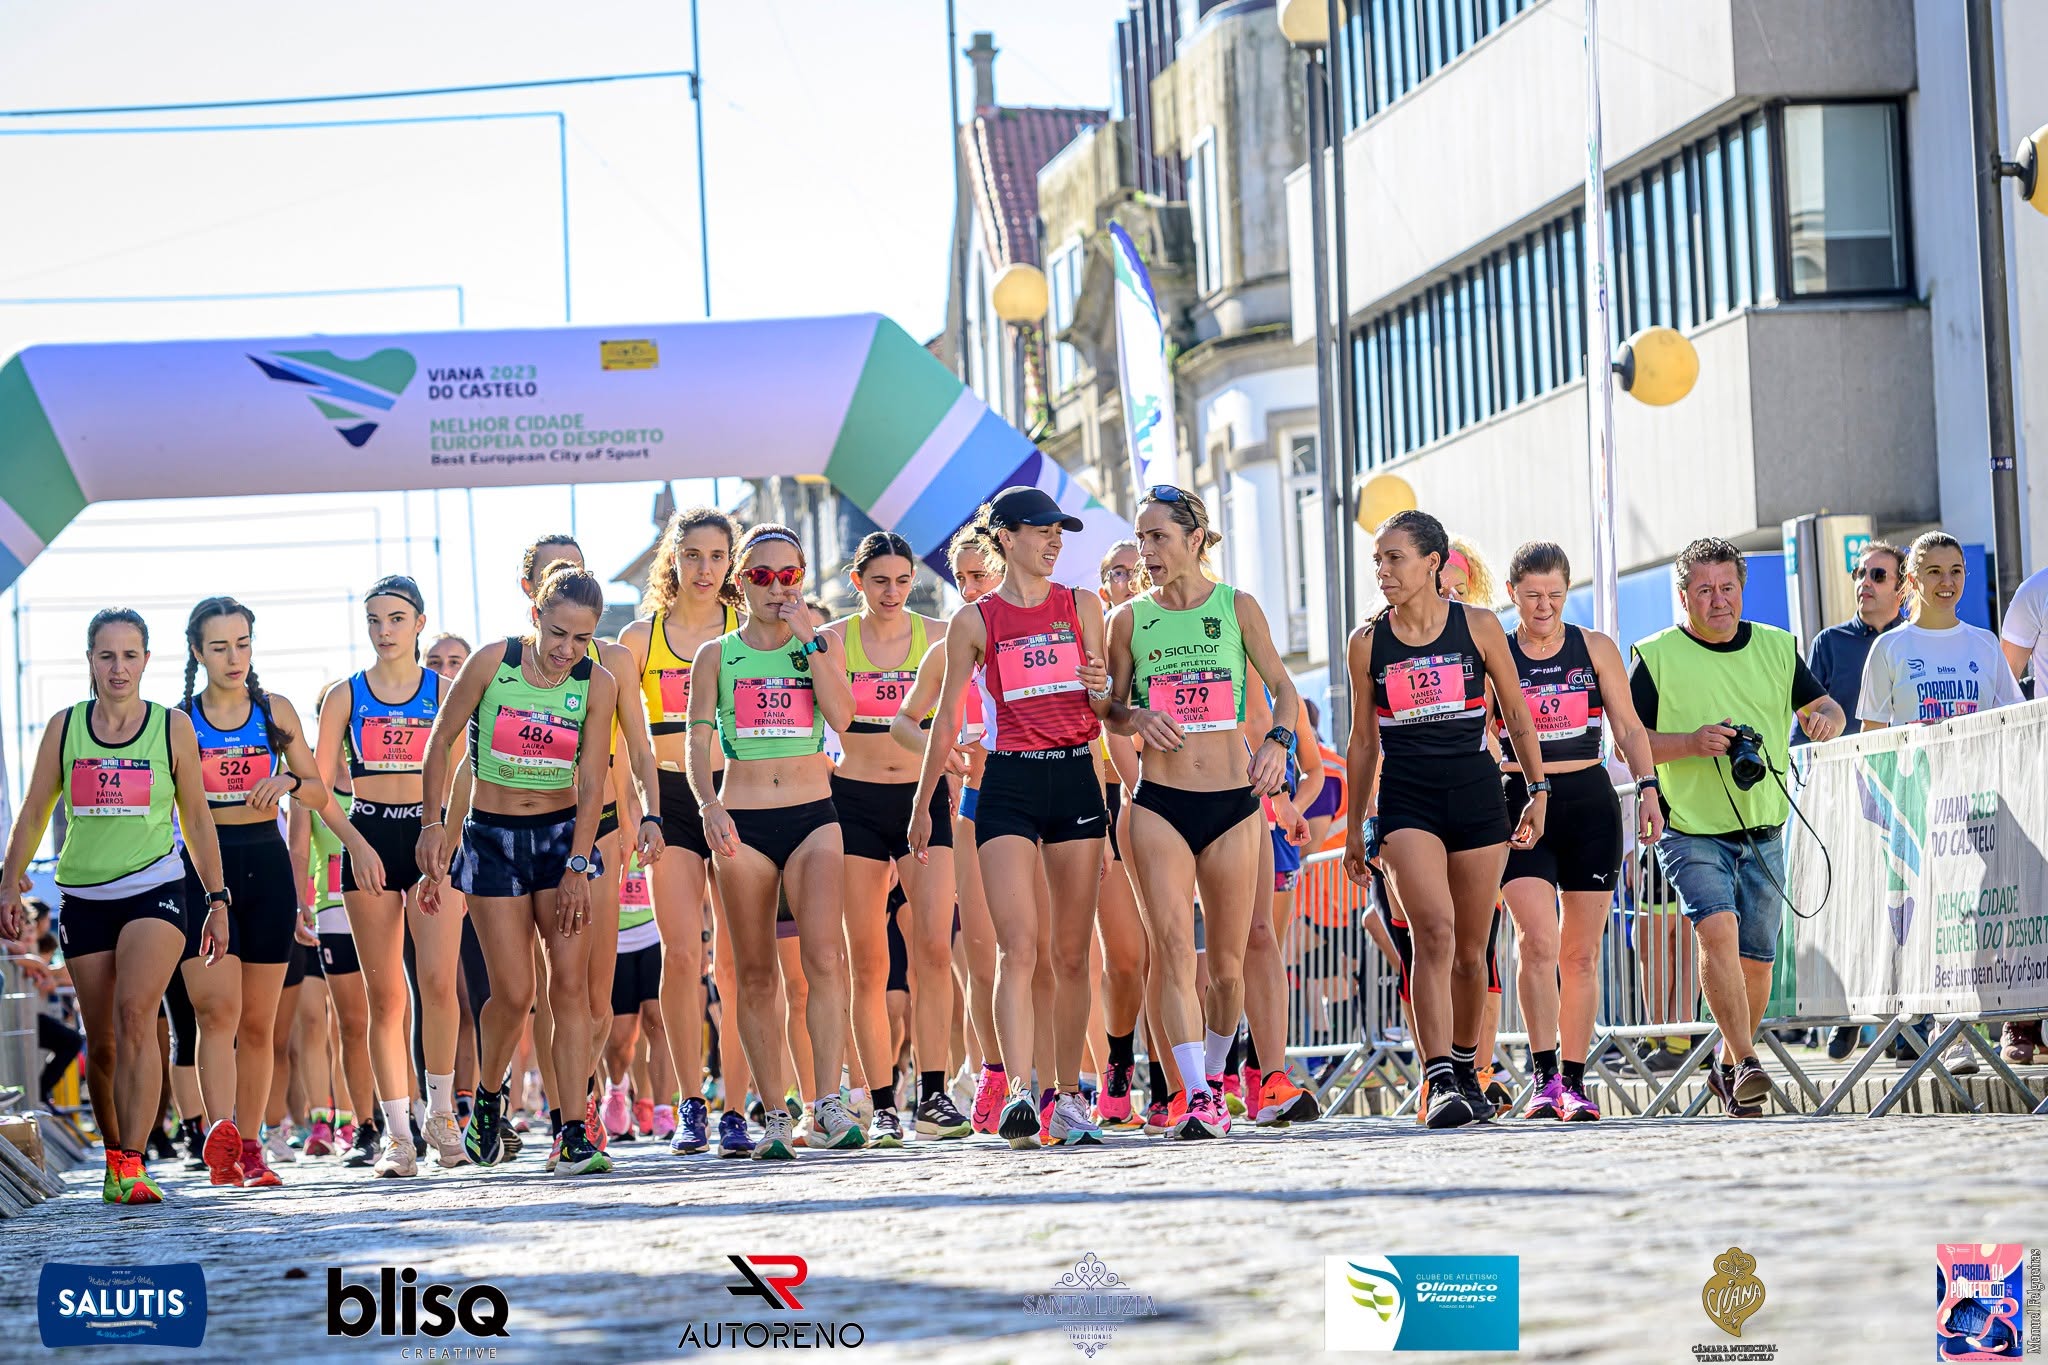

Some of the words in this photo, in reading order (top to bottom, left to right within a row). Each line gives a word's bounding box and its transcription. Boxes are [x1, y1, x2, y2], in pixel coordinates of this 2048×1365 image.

[428, 367, 484, 382] VIANA
[490, 365, 537, 380] 2023
[429, 384, 453, 400] DO
[459, 382, 537, 399] CASTELO
[430, 416, 510, 434] MELHOR
[515, 414, 584, 431] CIDADE
[431, 433, 524, 450] EUROPEIA
[530, 432, 557, 448] DO
[563, 429, 664, 446] DESPORTO
[431, 453, 464, 466] Best
[471, 451, 545, 466] European
[550, 448, 580, 463] City
[585, 449, 602, 460] of
[606, 447, 649, 463] Sport
[1023, 648, 1058, 669] 586
[1154, 662, 1178, 673] CLUBE
[1407, 670, 1441, 690] 123
[1174, 686, 1209, 705] 579
[1411, 688, 1443, 700] VANESSA
[1414, 695, 1441, 705] ROCHA
[1917, 680, 1965, 703] CORRIDA
[1966, 680, 1979, 701] DA
[757, 692, 791, 709] 350
[1540, 698, 1560, 715] 69
[763, 710, 785, 718] TÂNIA
[1176, 706, 1209, 715] MÓNICA
[1183, 714, 1205, 722] SILVA
[1919, 701, 1955, 720] PONTE
[1535, 715, 1568, 724] FLORINDA
[382, 730, 414, 745] 527
[518, 725, 553, 745] 486
[1020, 750, 1045, 760] NIKE
[1045, 750, 1066, 760] PRO
[1072, 745, 1090, 757] NIKE
[219, 760, 251, 776] 526
[517, 766, 561, 777] PREVENT
[98, 772, 121, 788] 94
[96, 790, 123, 798] FÁTIMA
[382, 804, 423, 819] NIKE
[1934, 795, 1970, 824] VIANA
[1971, 789, 1997, 820] 2023
[1931, 831, 1948, 858] DO
[1951, 823, 1995, 856] CASTELO
[1937, 891, 1976, 921] MELHOR
[1978, 885, 2018, 917] CIDADE
[1935, 923, 1980, 954] EUROPEIA
[1983, 921, 2003, 950] DO
[1935, 964, 1954, 988] Best
[1955, 963, 1993, 992] European
[1995, 957, 2016, 990] City
[2018, 955, 2027, 982] of
